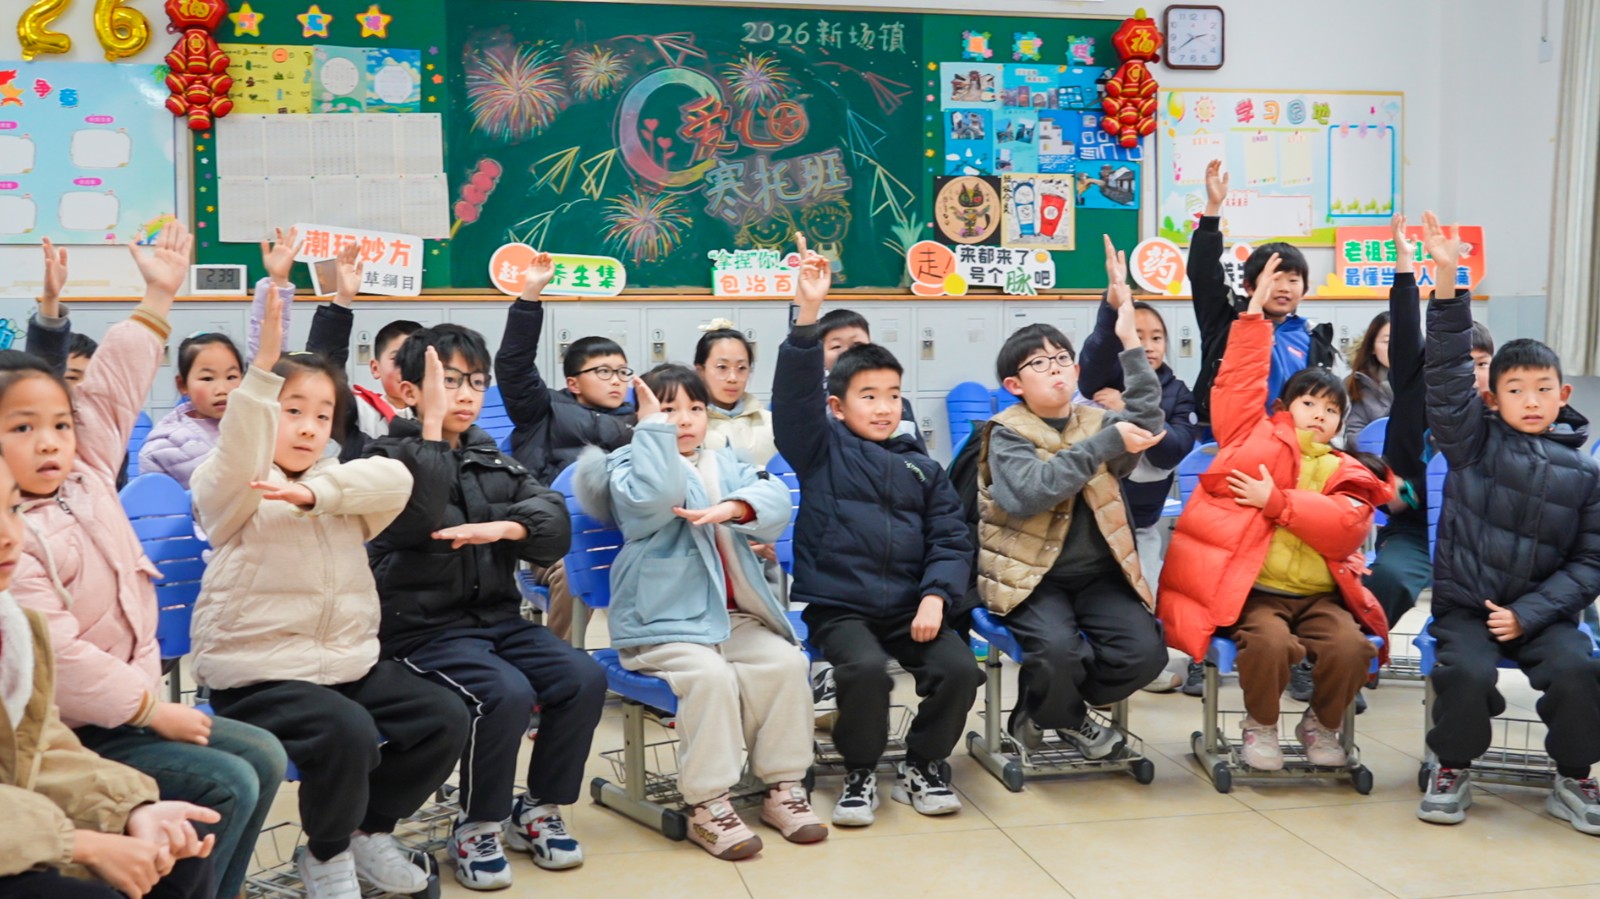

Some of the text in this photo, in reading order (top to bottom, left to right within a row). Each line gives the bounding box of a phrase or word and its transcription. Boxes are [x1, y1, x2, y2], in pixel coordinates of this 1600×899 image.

[1131, 29, 1155, 52] 福
[1235, 98, 1331, 125] 学习园地
[704, 151, 848, 220] 寒托班
[960, 246, 1030, 265] 来都来了
[1142, 245, 1178, 285] 药
[969, 267, 1051, 295] 号个脉吧
